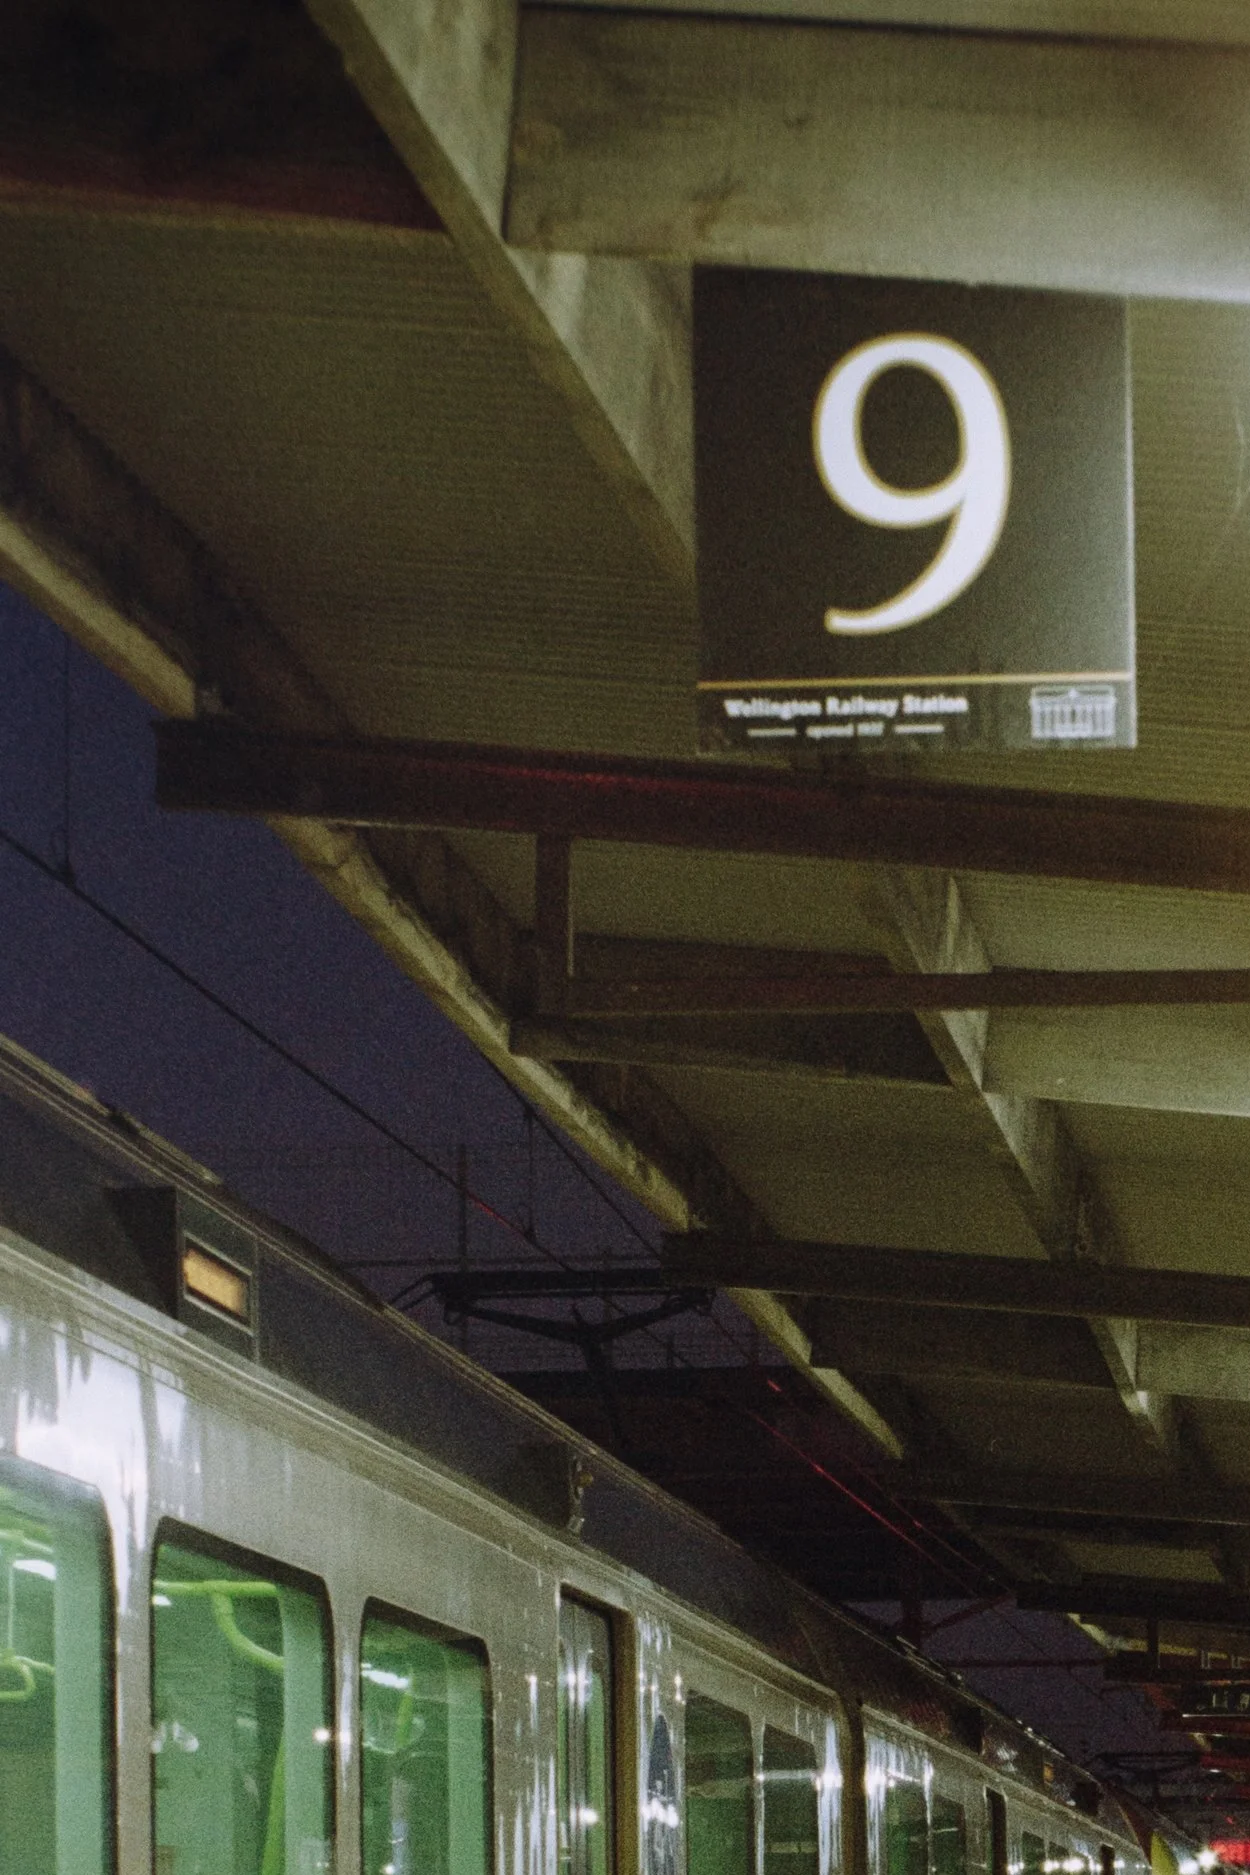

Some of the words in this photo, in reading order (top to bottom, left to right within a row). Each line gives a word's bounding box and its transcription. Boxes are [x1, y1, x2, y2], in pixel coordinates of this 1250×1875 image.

[813, 333, 1012, 636] 9
[724, 698, 822, 720] Wellington
[826, 696, 899, 718] Railway
[902, 695, 969, 714] Station
